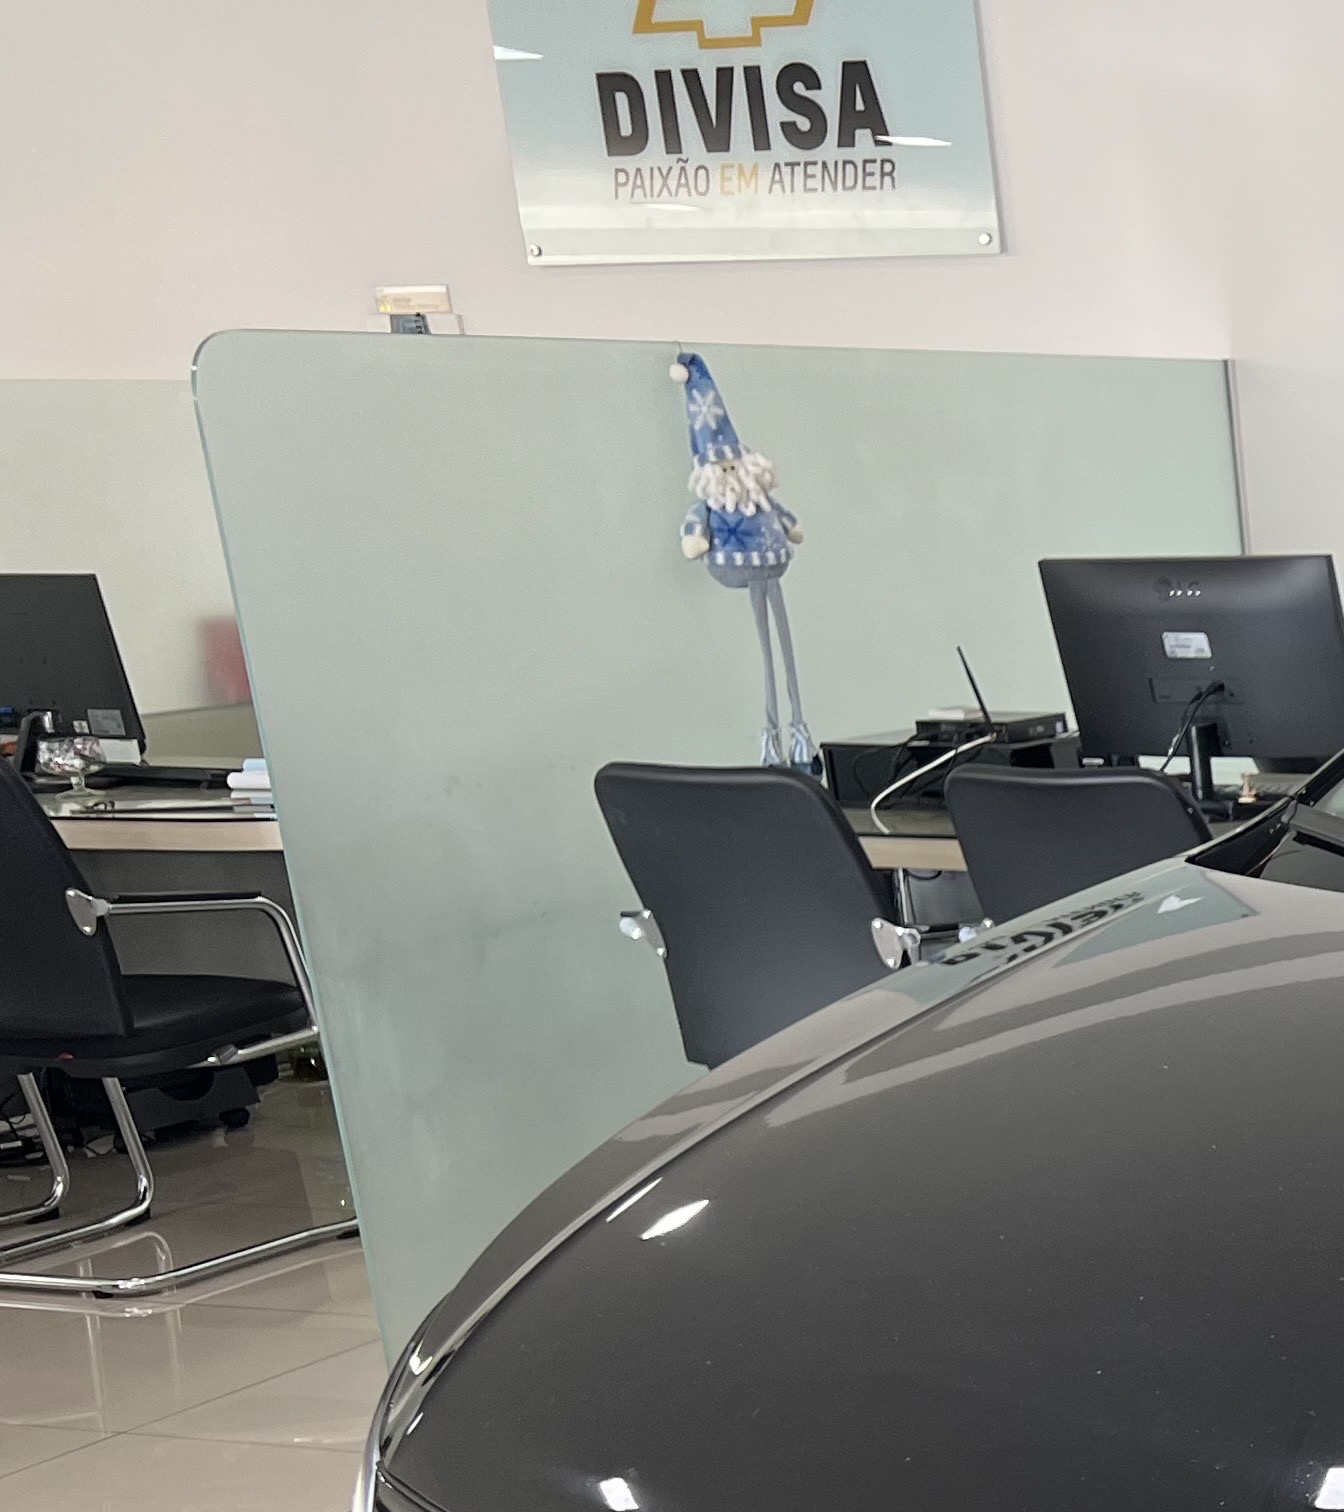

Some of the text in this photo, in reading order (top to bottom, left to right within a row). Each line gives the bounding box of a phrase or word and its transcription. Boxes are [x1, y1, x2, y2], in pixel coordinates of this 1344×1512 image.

[595, 60, 893, 157] DIVISA
[613, 157, 897, 200] PAIXÃO EM ATENDER
